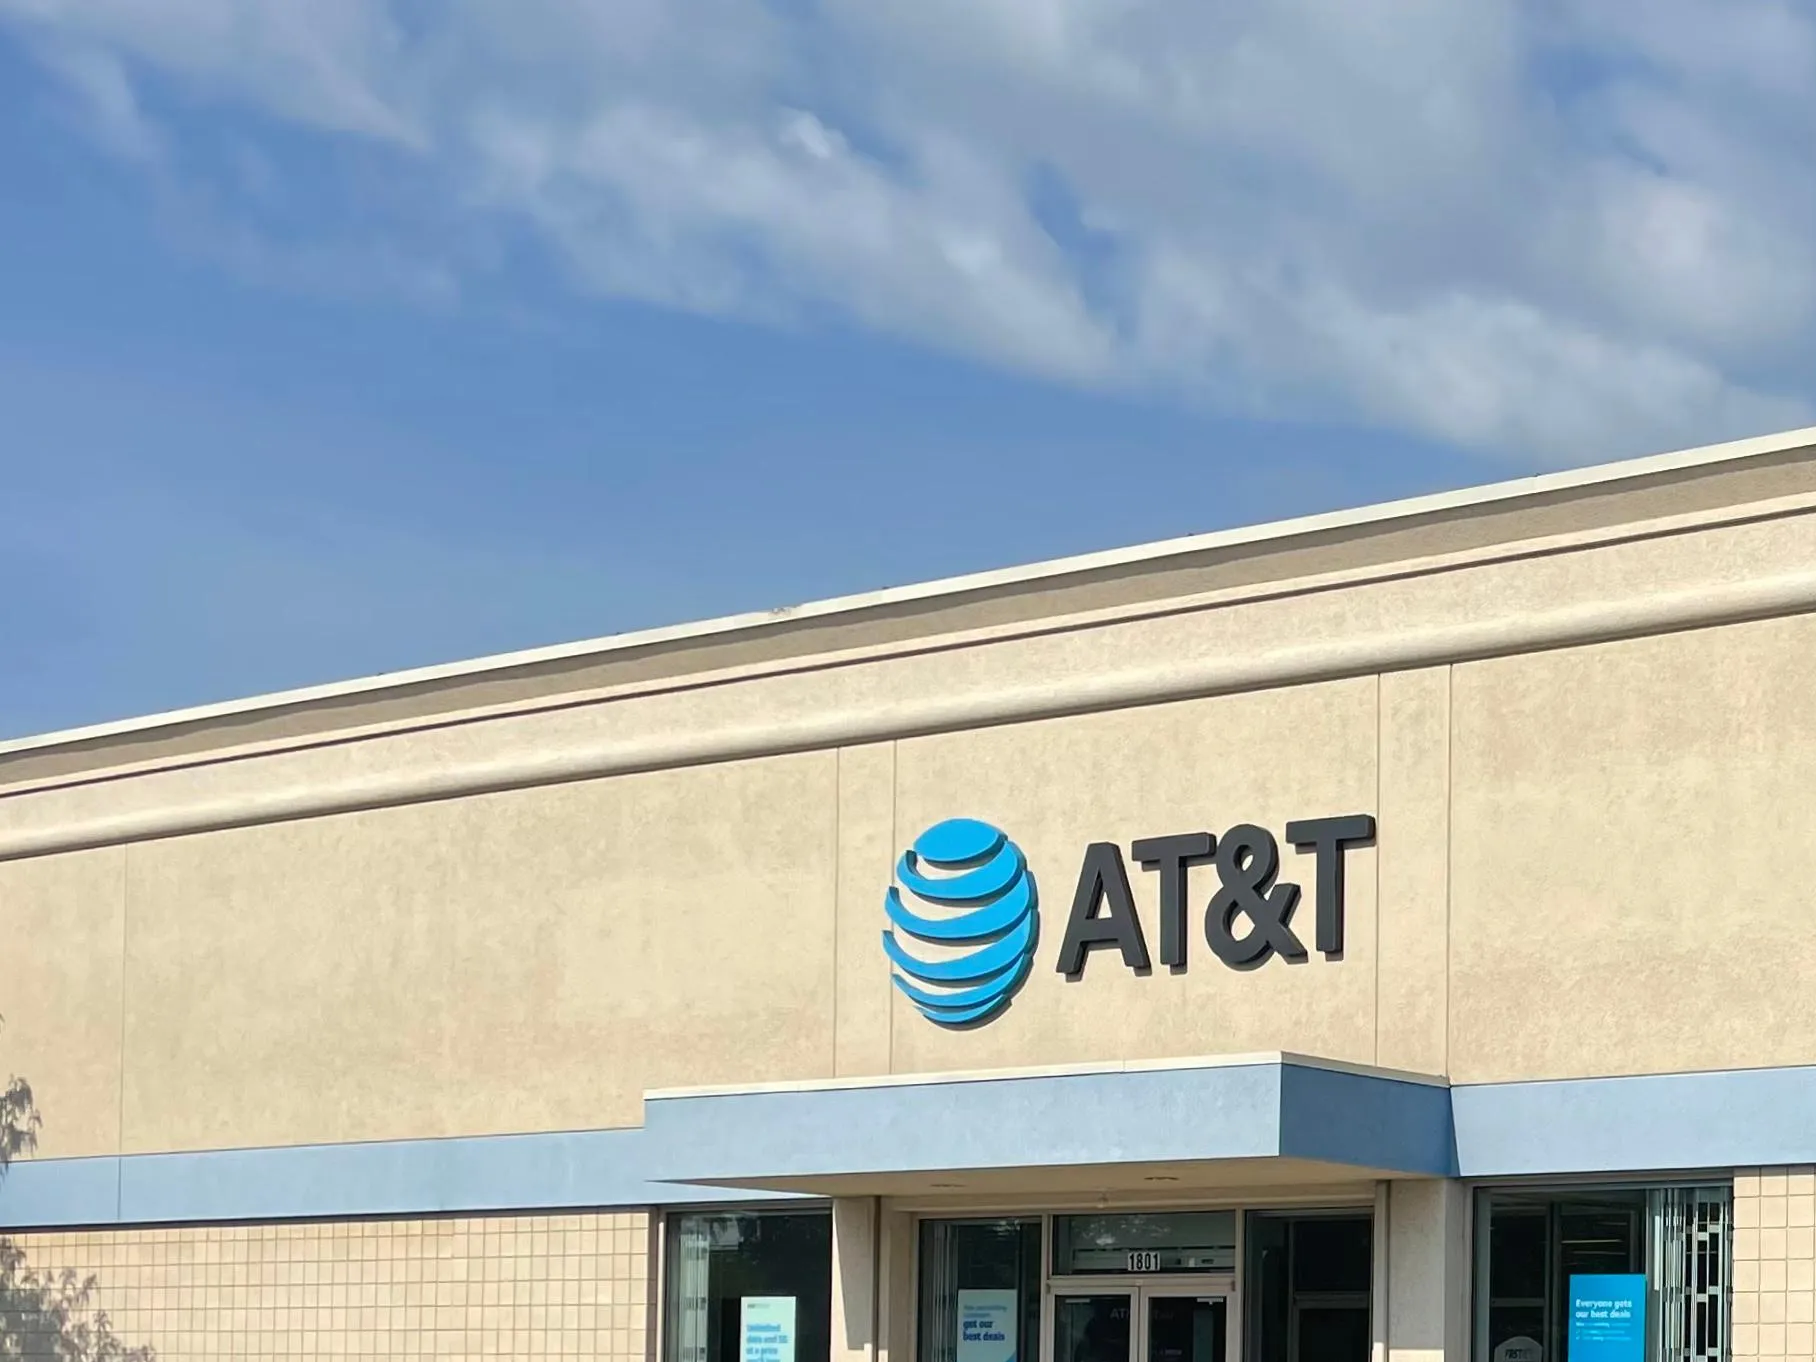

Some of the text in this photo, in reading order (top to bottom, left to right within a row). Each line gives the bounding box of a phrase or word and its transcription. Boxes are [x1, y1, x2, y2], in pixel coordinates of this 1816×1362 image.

[1056, 814, 1375, 974] AT&T
[1129, 1252, 1158, 1271] 1801
[1576, 1299, 1612, 1309] Everyone
[1590, 1310, 1608, 1318] best
[1609, 1310, 1631, 1318] deals
